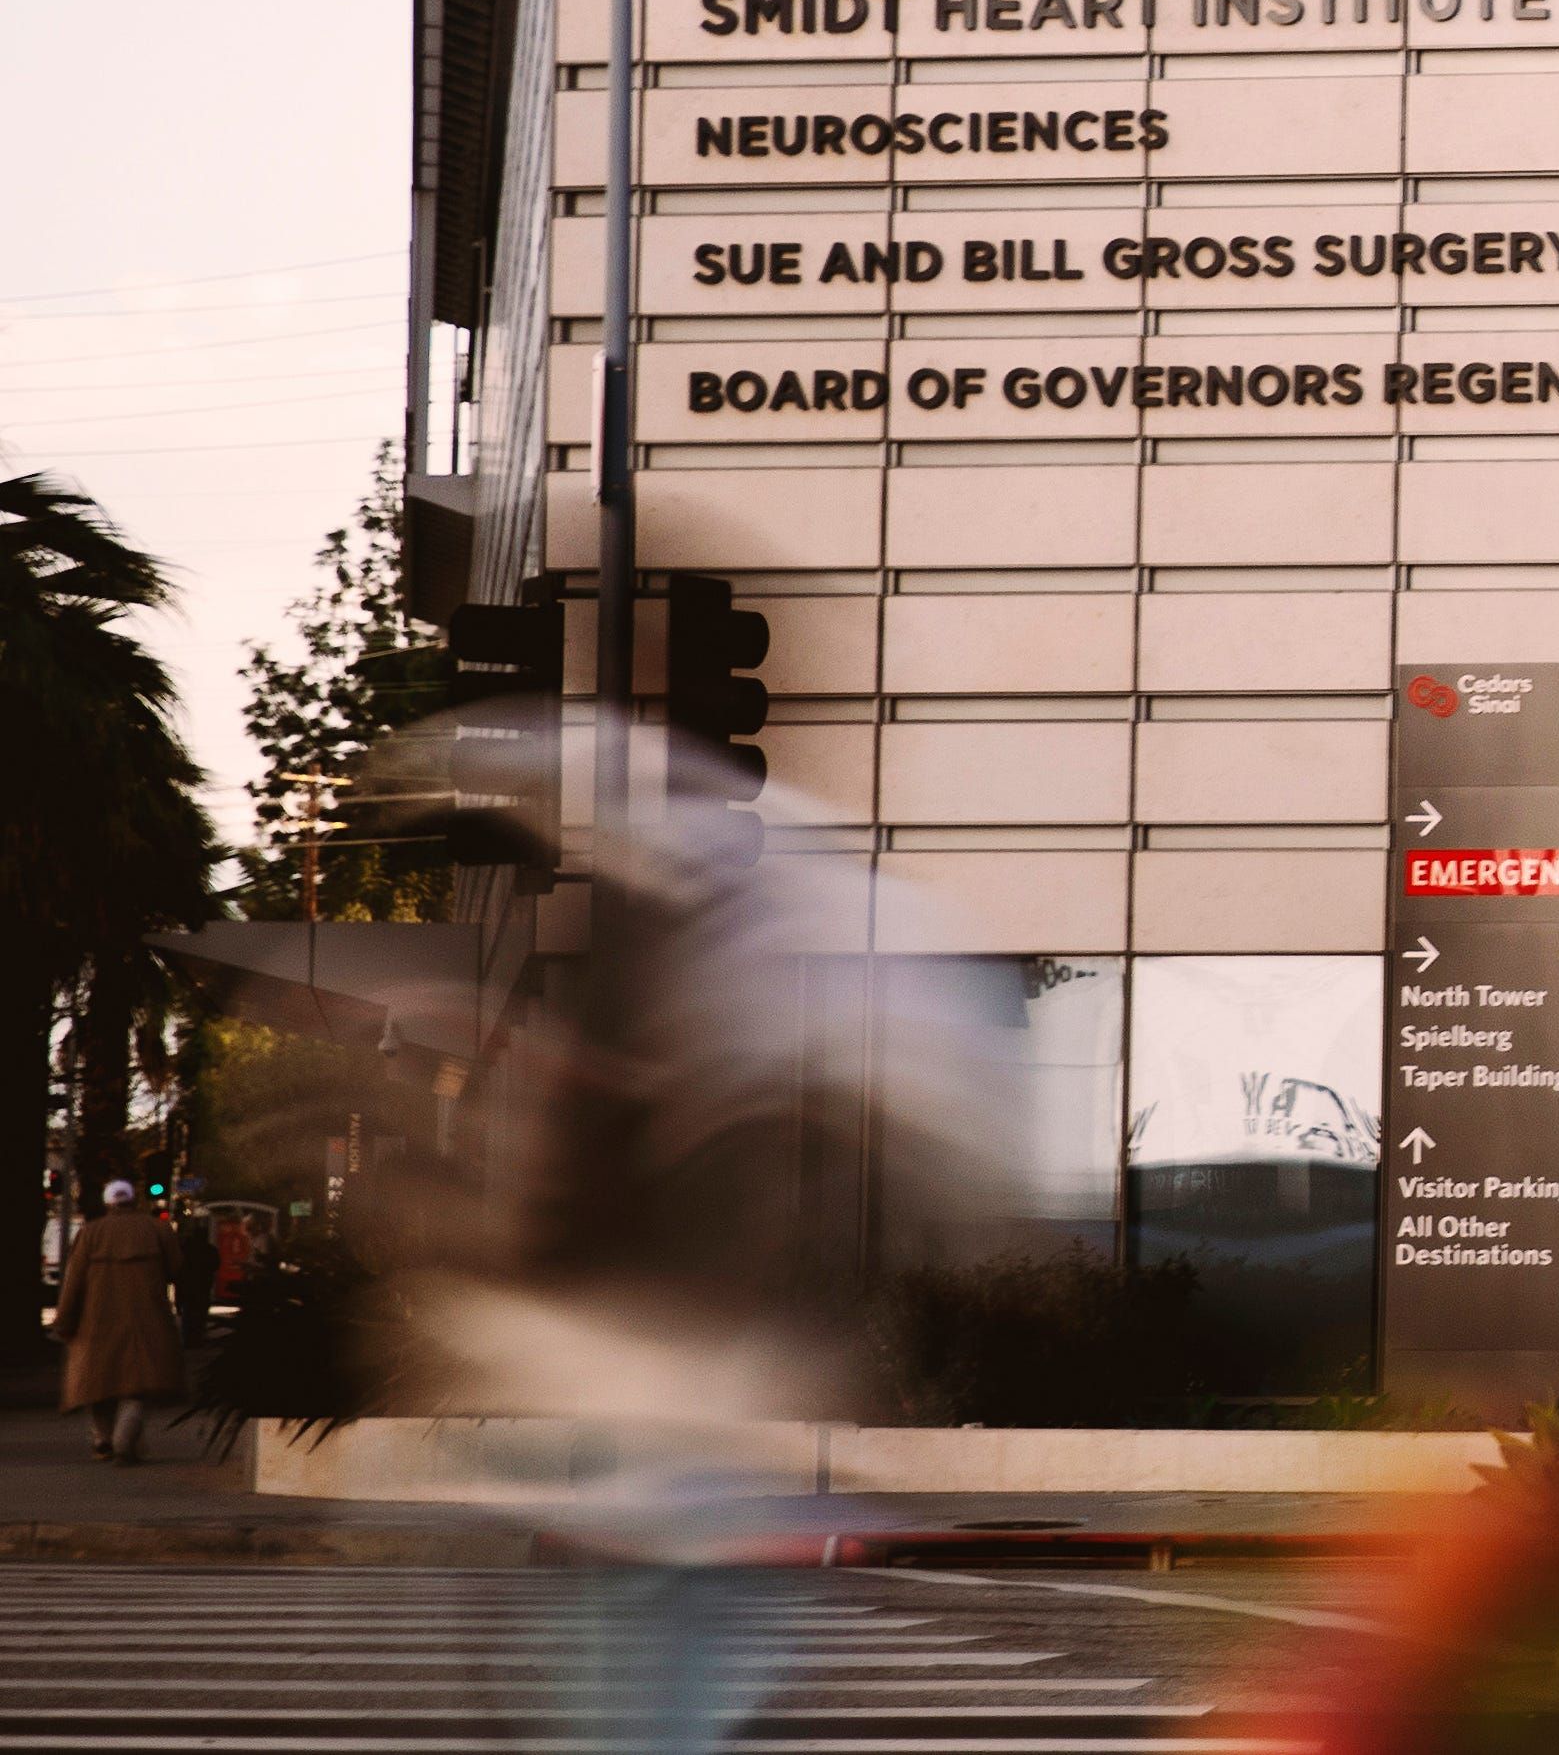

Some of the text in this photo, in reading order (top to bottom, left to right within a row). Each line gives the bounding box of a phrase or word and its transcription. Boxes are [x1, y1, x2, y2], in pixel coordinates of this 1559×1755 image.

[696, 110, 1169, 158] NEUROSCIENCES
[693, 244, 801, 285] SUE
[819, 241, 943, 283] AND
[962, 239, 1083, 281] BILL
[1103, 237, 1295, 279] GROSS
[688, 371, 889, 413] BOARD
[908, 369, 987, 409] OF
[1002, 363, 1363, 408] GOVERNORS
[1457, 674, 1533, 693] Cedars
[1468, 695, 1521, 715] Sinai
[1401, 985, 1548, 1007] North Tower
[1400, 1025, 1513, 1052] Spielberg
[1400, 1066, 1468, 1092] Taper
[1398, 1177, 1479, 1198] Visitor
[1397, 1216, 1511, 1238] All Other
[1396, 1244, 1552, 1266] Destinations
